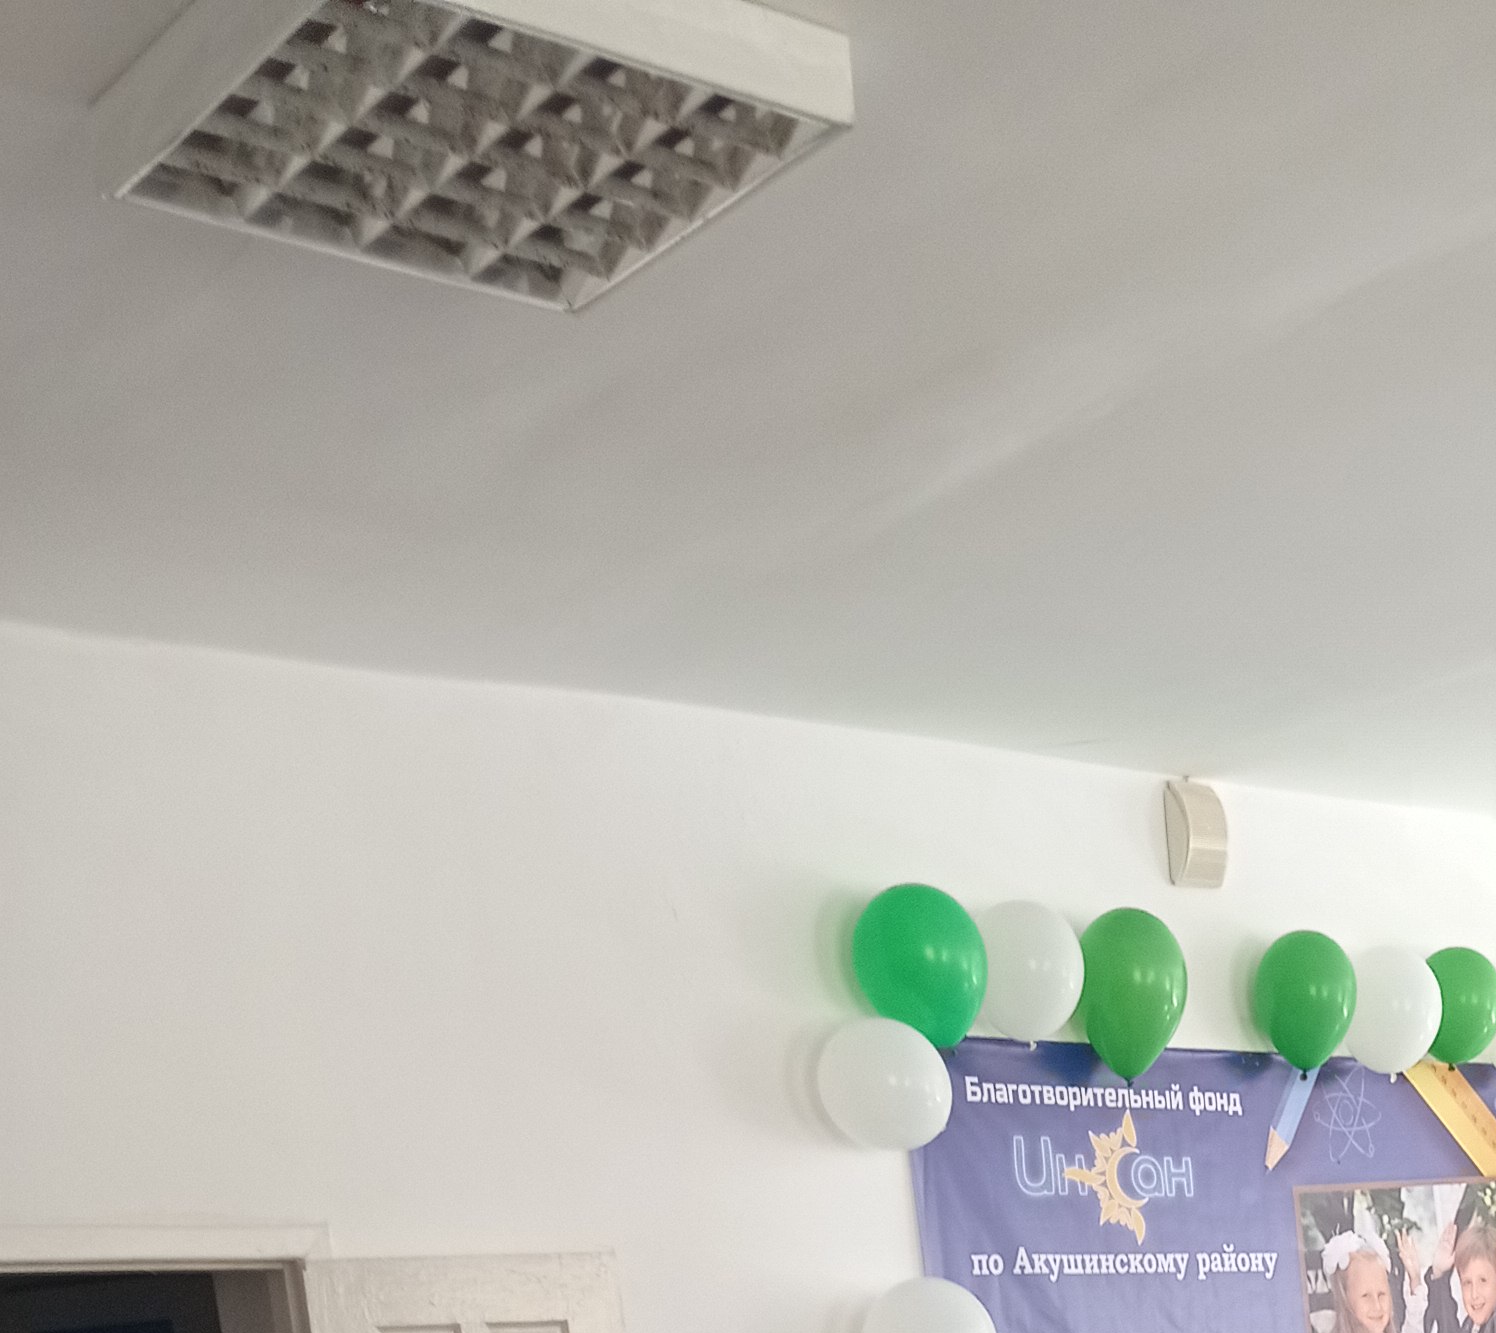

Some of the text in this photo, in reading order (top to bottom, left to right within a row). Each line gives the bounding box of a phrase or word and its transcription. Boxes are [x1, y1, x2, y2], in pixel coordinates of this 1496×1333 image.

[964, 1076, 1243, 1116] Благотворительный фонд
[971, 1244, 1278, 1282] по Акушинскому району
